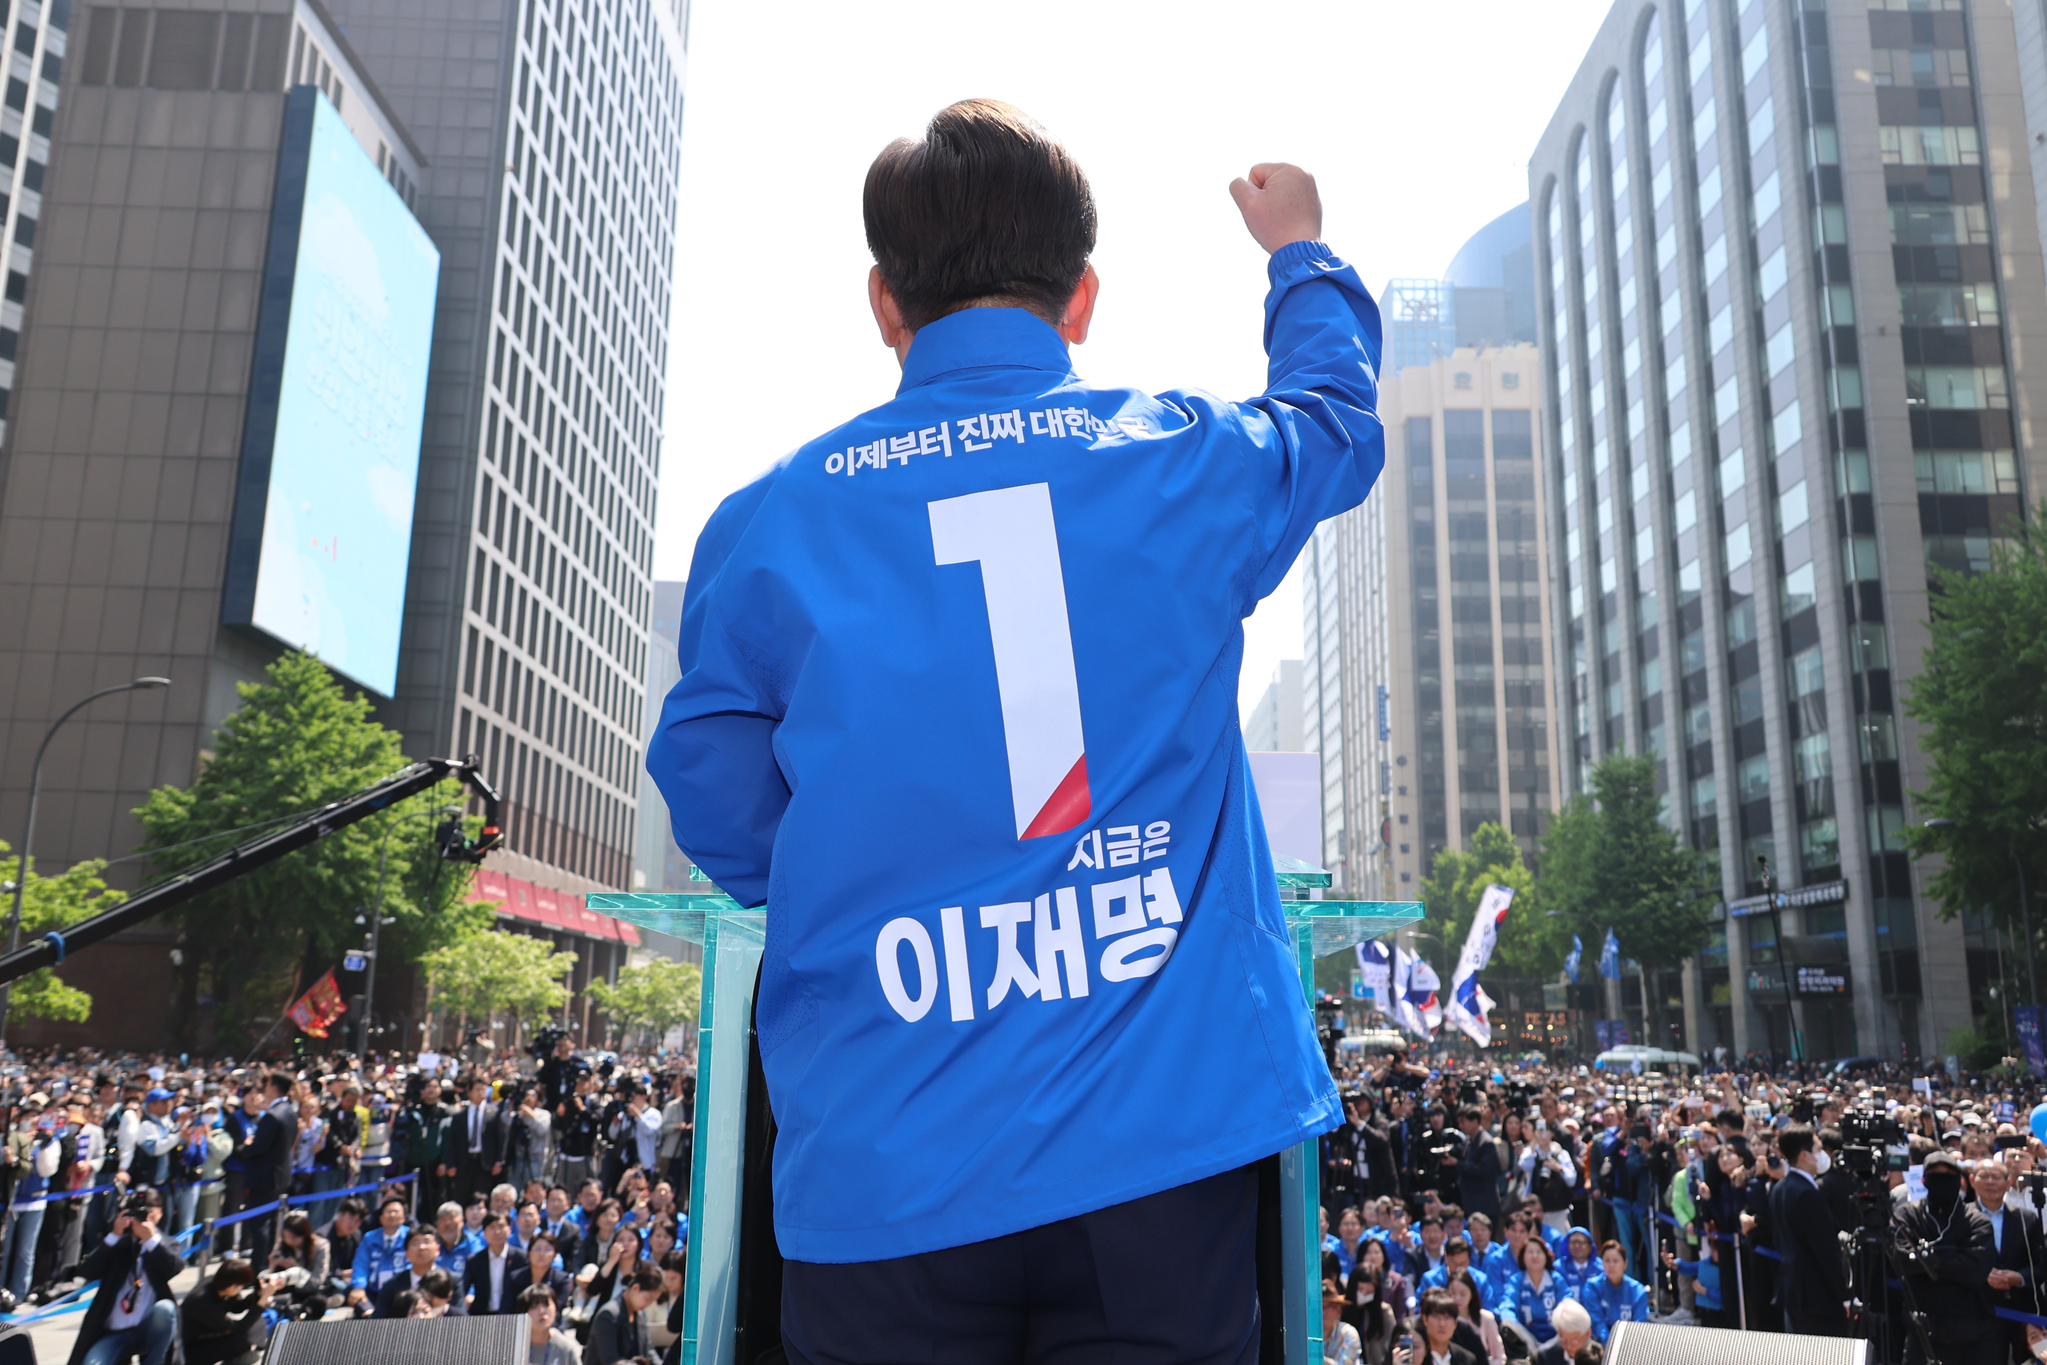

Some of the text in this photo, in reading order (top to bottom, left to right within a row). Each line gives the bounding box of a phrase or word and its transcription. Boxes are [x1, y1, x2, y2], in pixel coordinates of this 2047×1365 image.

[825, 421, 952, 476] 이제부터
[957, 408, 1026, 453] 진짜
[927, 482, 1091, 841] 1
[1067, 820, 1171, 871] 지금은
[875, 867, 1184, 1023] 이재명
[1524, 1012, 1567, 1026] TEAS
